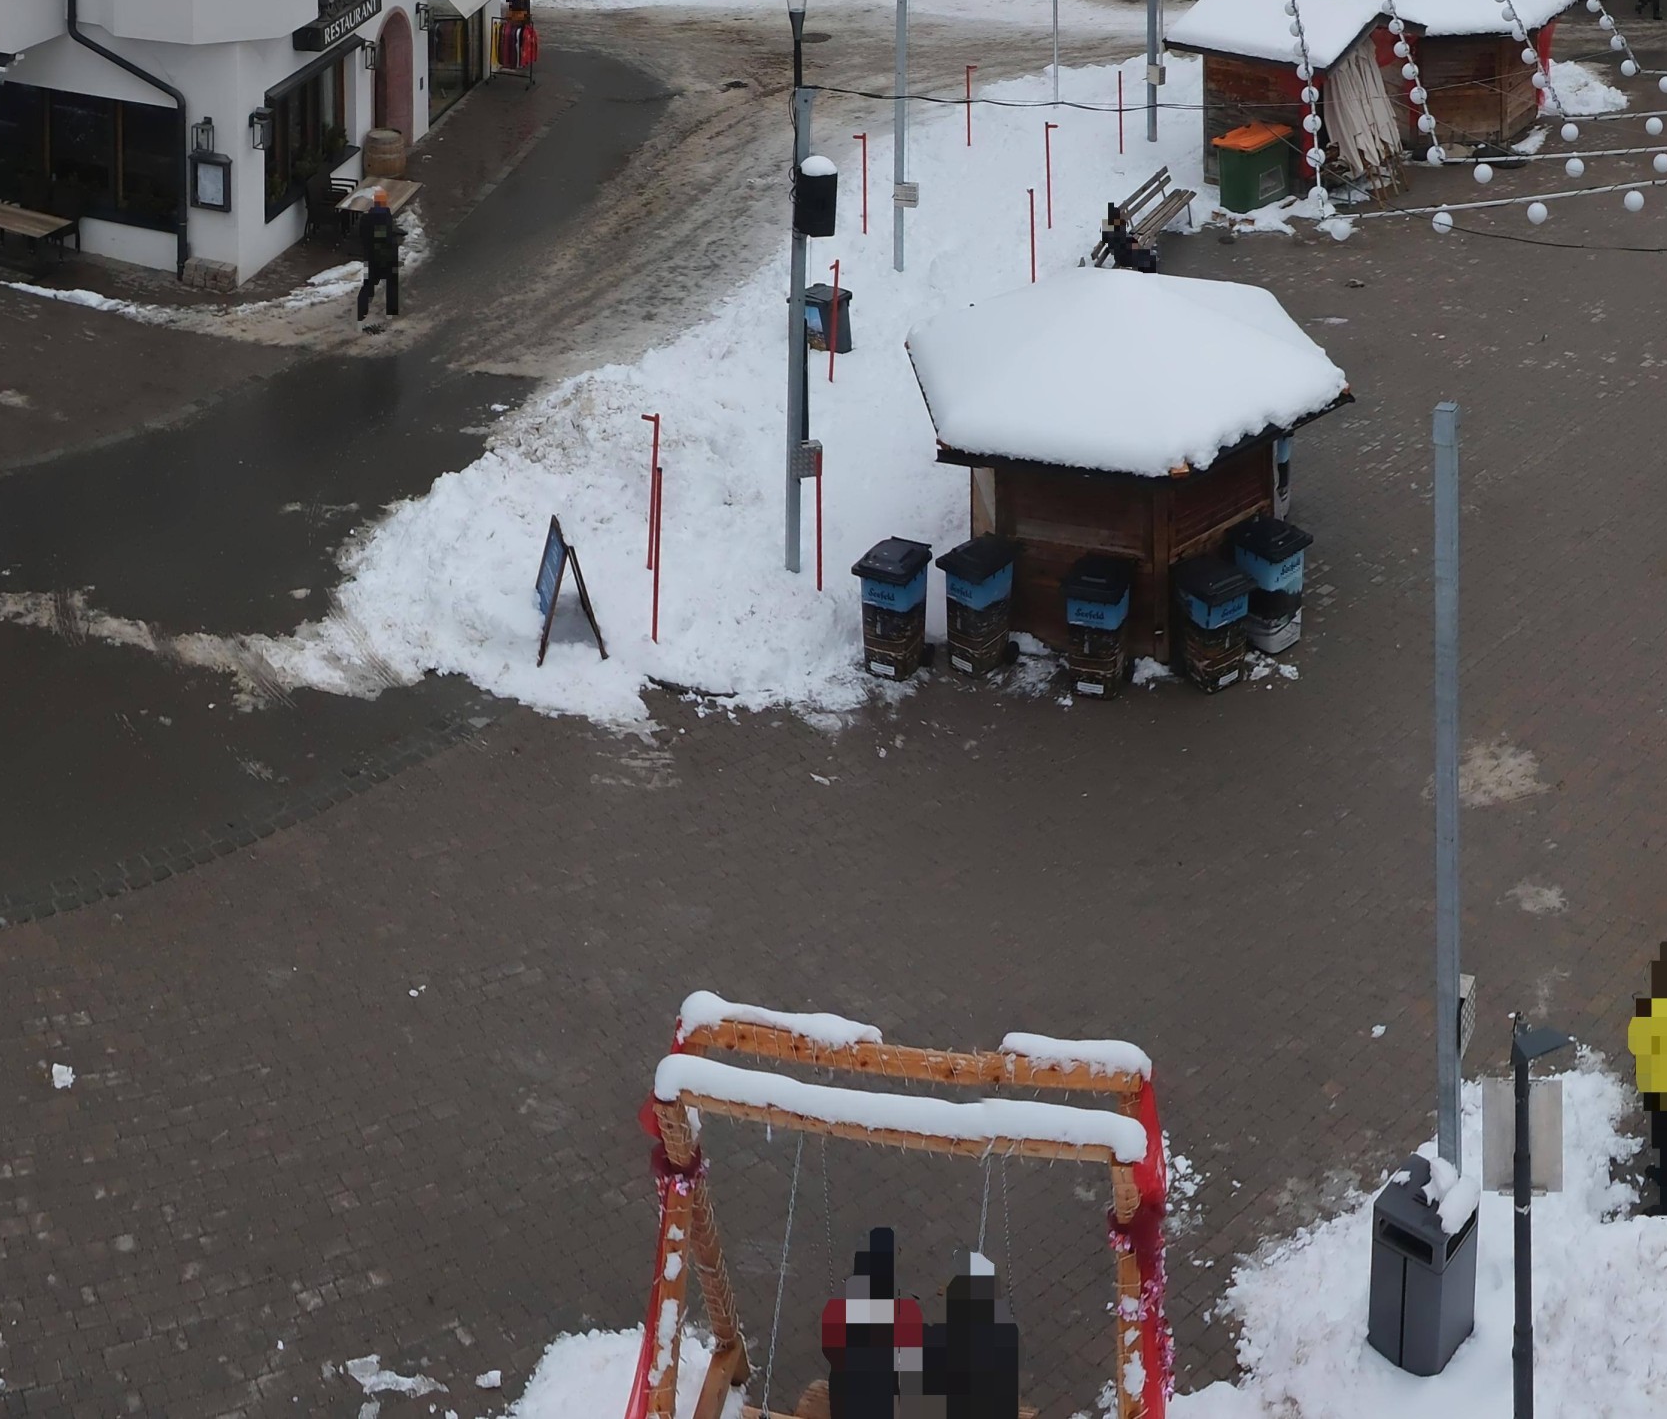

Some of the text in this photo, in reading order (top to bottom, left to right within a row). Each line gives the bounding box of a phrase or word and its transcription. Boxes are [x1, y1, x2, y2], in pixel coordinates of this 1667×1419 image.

[868, 587, 895, 601] Seefeld
[1075, 608, 1105, 620] Seefeld
[1221, 603, 1243, 619] Seefeld
